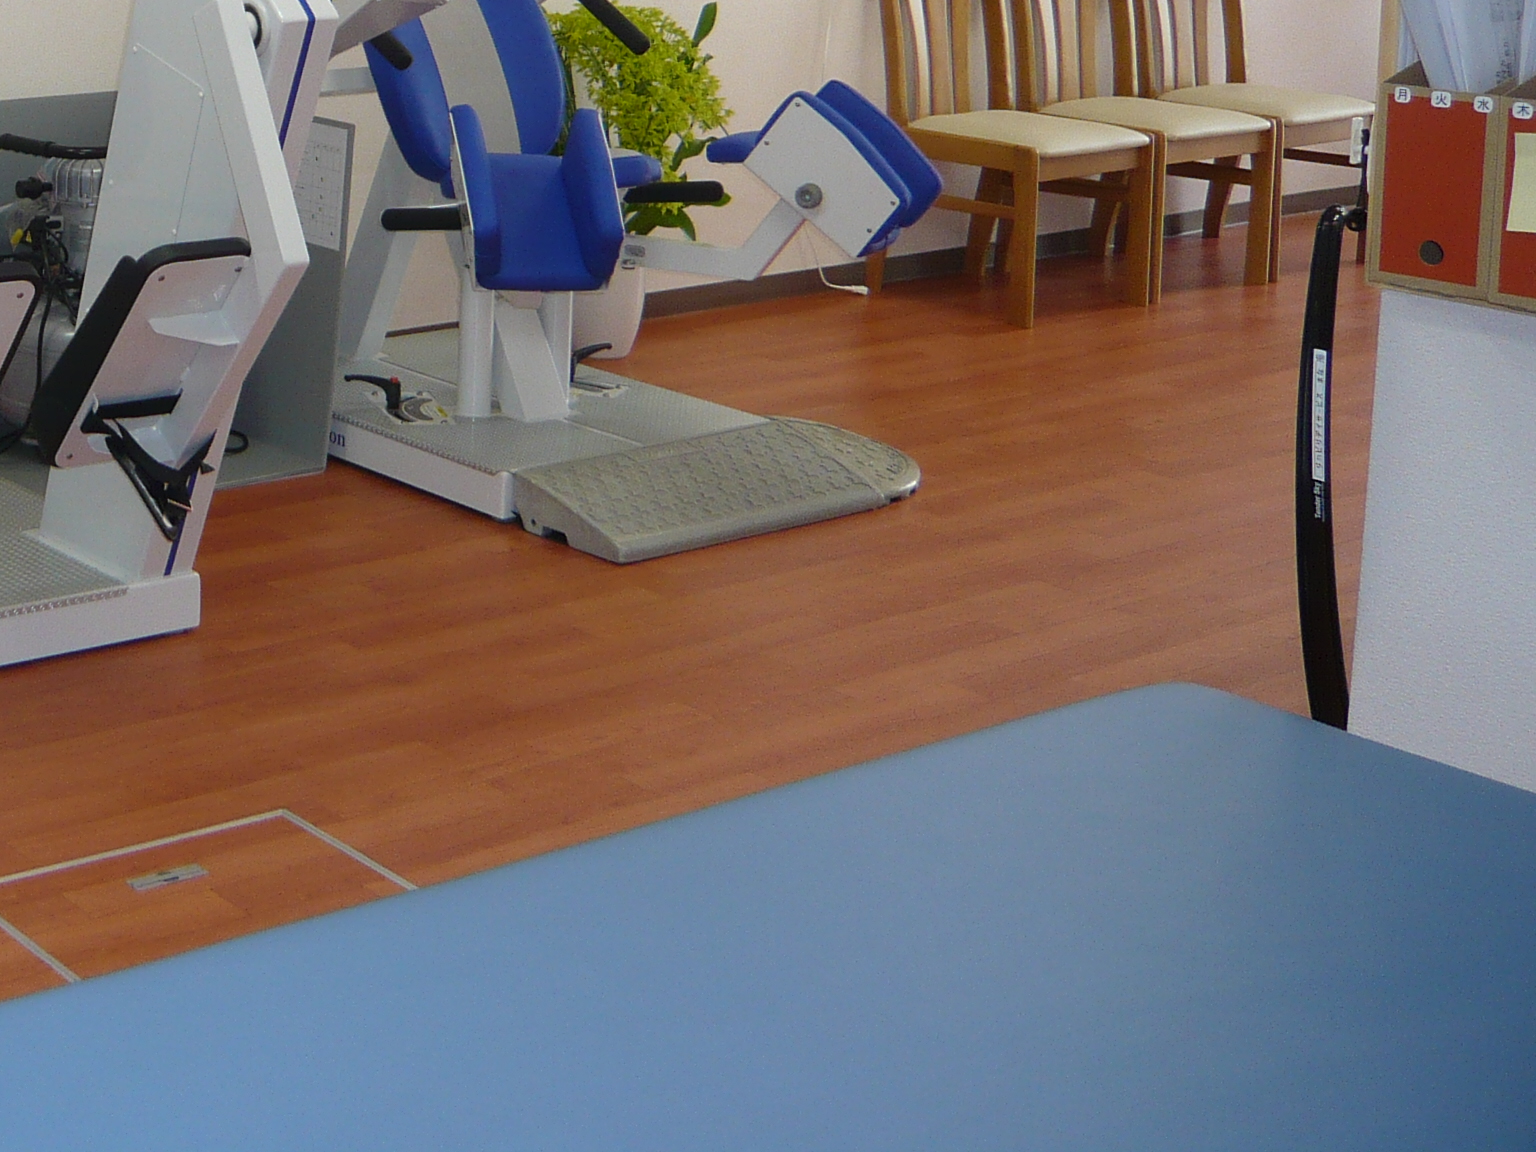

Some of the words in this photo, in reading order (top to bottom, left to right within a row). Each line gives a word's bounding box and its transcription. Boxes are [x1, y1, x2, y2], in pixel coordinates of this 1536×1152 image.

[1397, 88, 1409, 101] 月
[1435, 93, 1448, 106] 火
[1477, 97, 1491, 111] 水
[1516, 103, 1531, 117] 木
